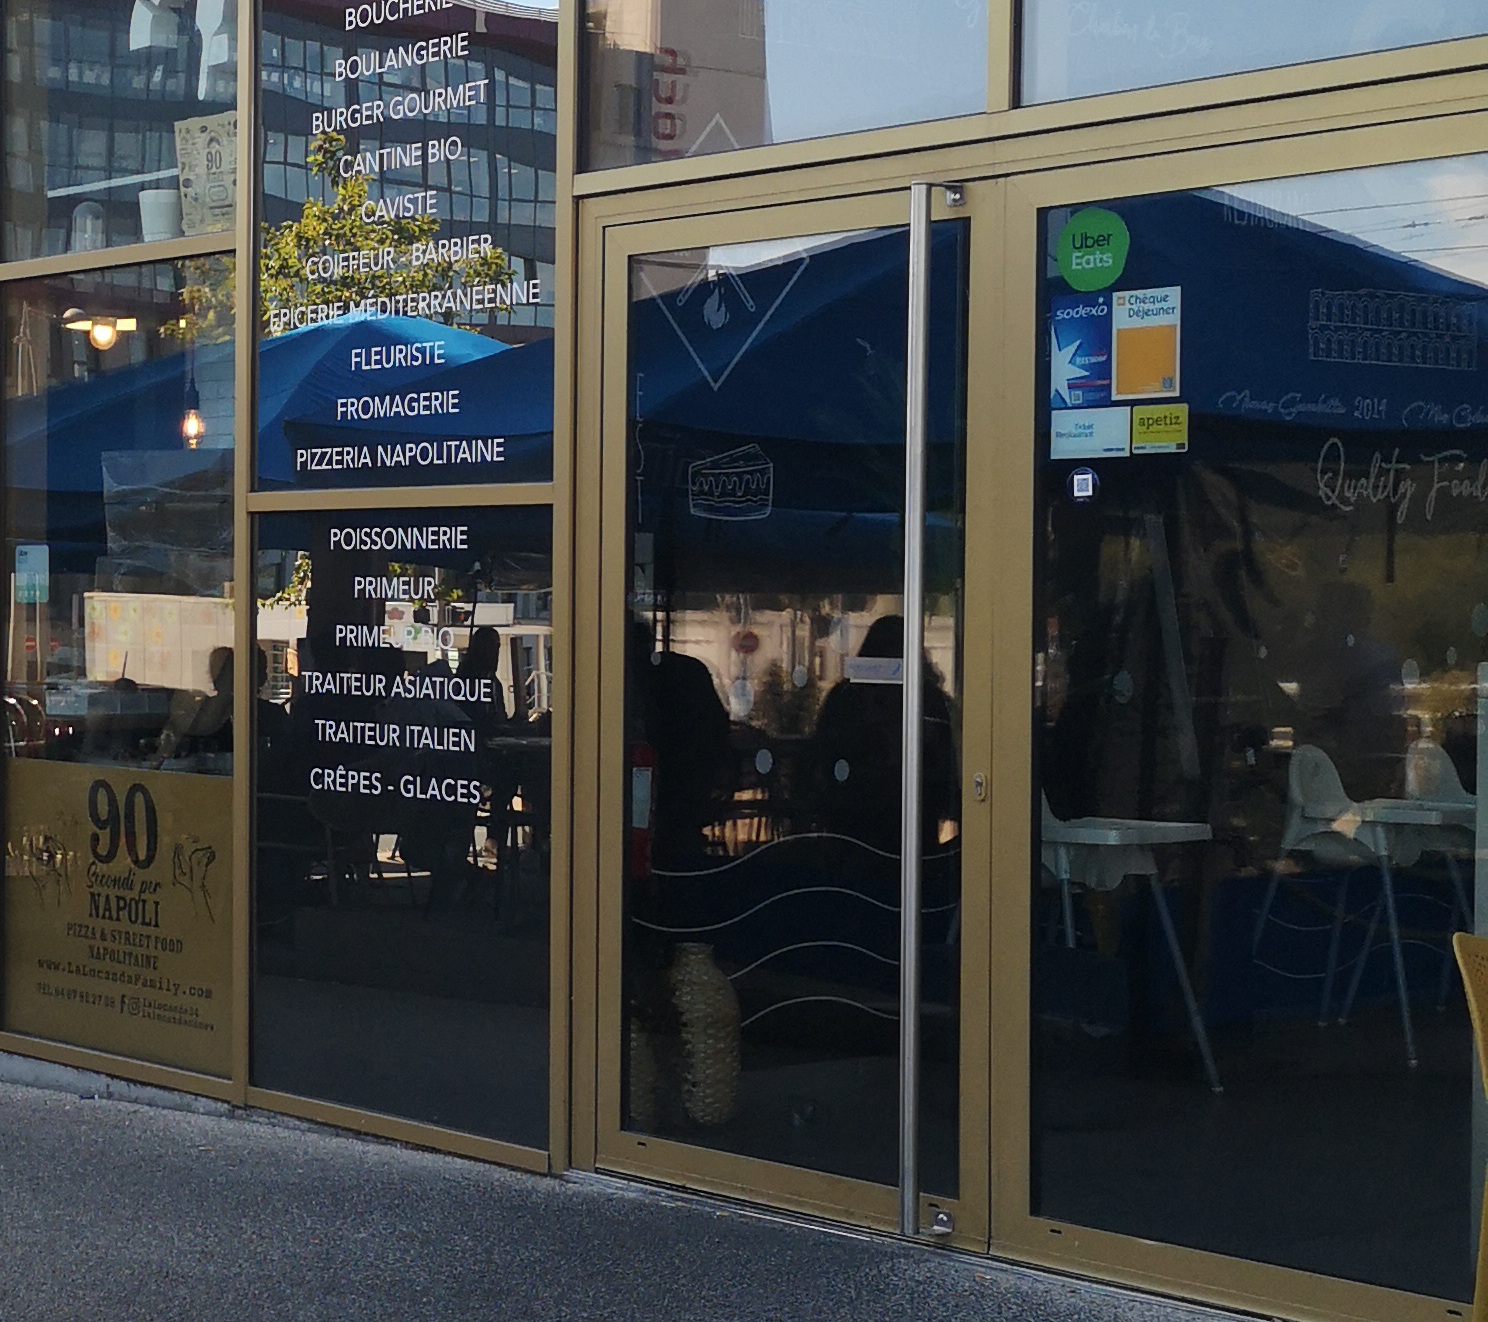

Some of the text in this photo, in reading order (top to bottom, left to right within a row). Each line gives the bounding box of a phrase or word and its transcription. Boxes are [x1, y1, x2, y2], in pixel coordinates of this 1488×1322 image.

[334, 32, 470, 82] BOULANGERIE
[312, 80, 489, 135] BURGER GOURMET
[339, 136, 462, 178] CANTINE BIO
[362, 190, 437, 223] CAVISTE
[306, 247, 394, 280] COIFFEUR
[412, 234, 492, 266] BARBIER
[1071, 232, 1113, 250] Uber
[1071, 252, 1113, 270] Eats
[269, 279, 541, 333] ÉPICERIE MÉDITERRANÉENNE
[1055, 296, 1109, 321] sodexo
[1128, 305, 1177, 320] Déjeuner
[351, 341, 445, 371] FLEURISTE
[336, 390, 460, 421] FROMAGERIE
[1138, 413, 1183, 429] apetiz
[296, 438, 505, 471] PIZZERIA NAPOLITAINE
[1317, 437, 1417, 525] Quality
[330, 526, 468, 551] POISSONNERIE
[354, 577, 435, 600] PRIMEUR
[335, 625, 455, 651] PRIMEUR BIO
[301, 671, 492, 702] TRAITEUR ASIATIQUE
[314, 719, 475, 752] TRAITEUR ITALIEN
[310, 765, 382, 795] CRÊPES
[400, 775, 481, 804] GLACES
[88, 778, 159, 870] 90
[138, 877, 161, 906] per
[88, 891, 160, 928] NAPOLI
[67, 922, 183, 955] PIZZA & STREET FOOD
[88, 944, 159, 970] NAPOLITAINE
